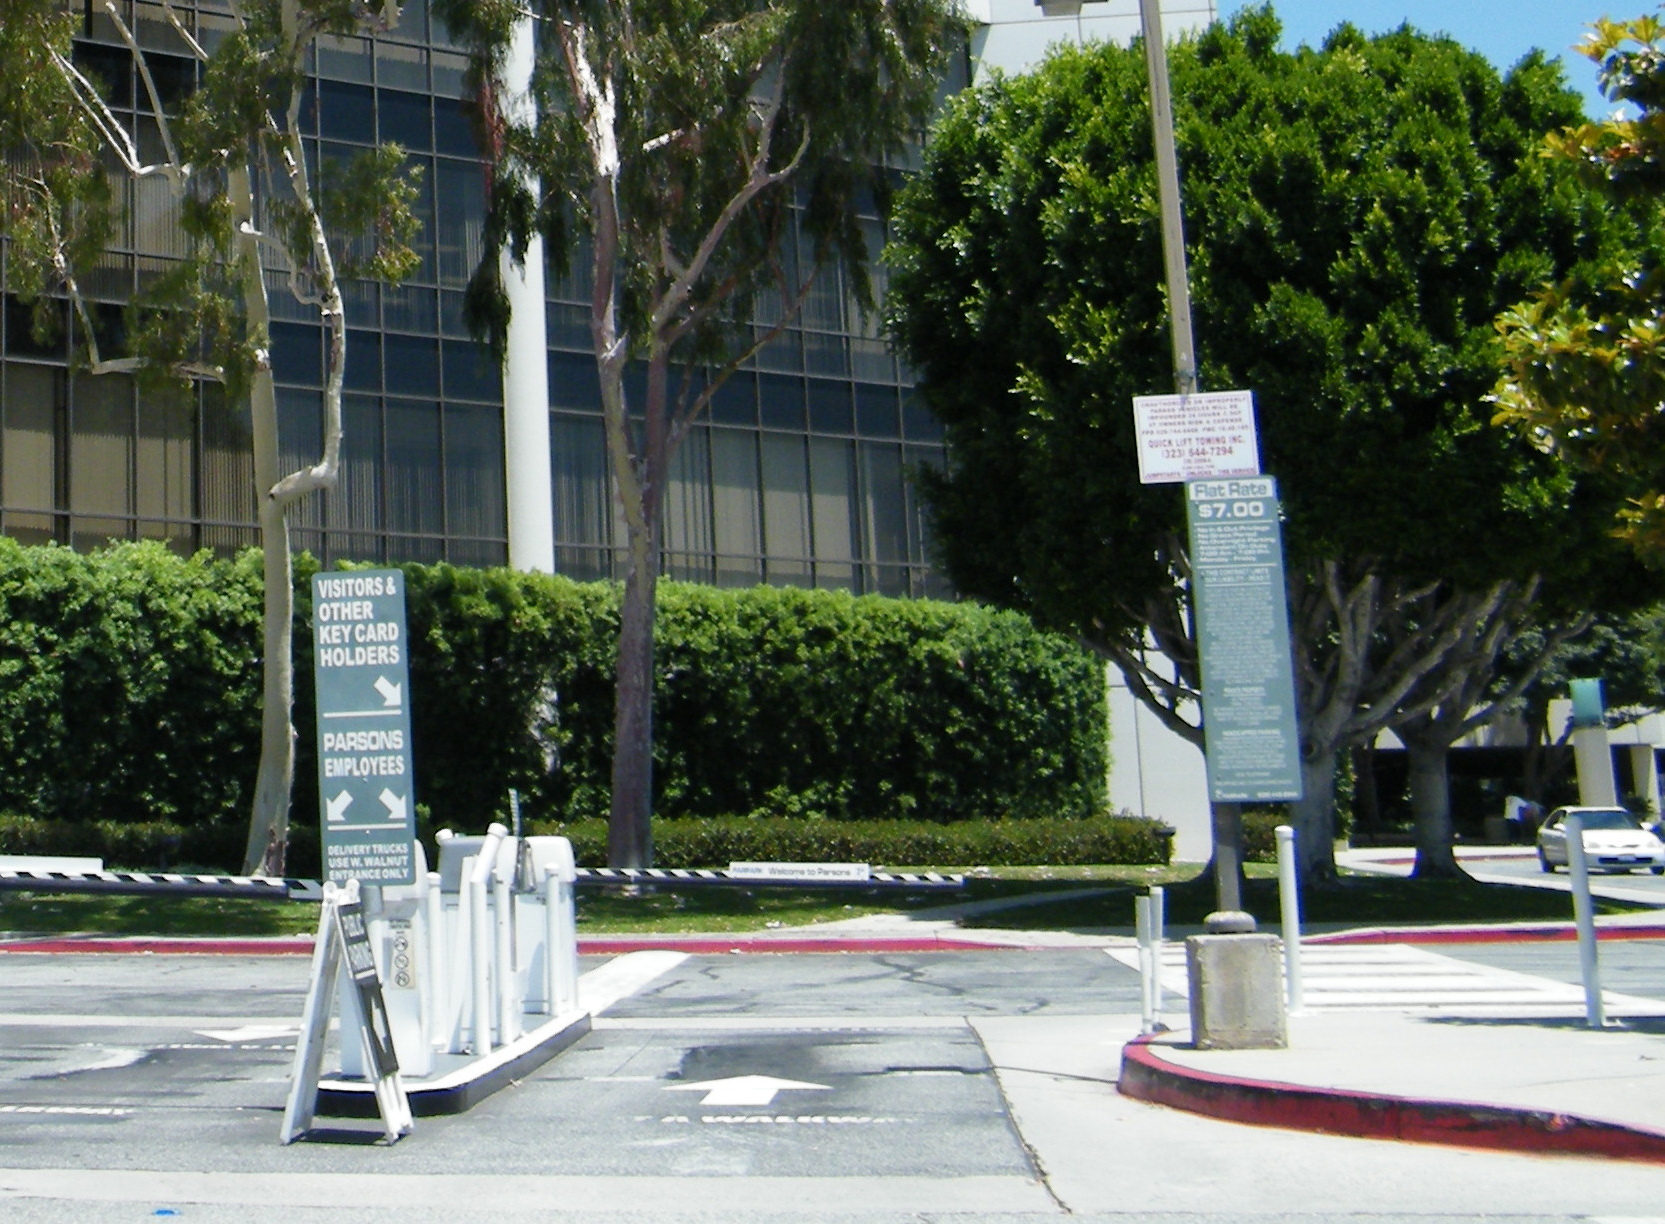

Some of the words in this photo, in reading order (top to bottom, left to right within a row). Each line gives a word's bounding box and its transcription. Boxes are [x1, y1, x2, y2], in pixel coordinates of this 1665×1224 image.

[1148, 439, 1173, 448] QUICK
[1176, 438, 1192, 447] LIFT
[1195, 436, 1226, 446] TOWING
[1162, 449, 1185, 458] (323)
[1195, 483, 1225, 497] Flat
[1229, 482, 1267, 496] Rate
[1198, 501, 1264, 518] $7.00
[318, 577, 383, 598] VISITORS
[386, 576, 396, 595] &
[319, 601, 374, 622] OTHER
[319, 624, 352, 644] KEY
[355, 622, 399, 642] CARD
[320, 645, 400, 667] HOLDERS
[323, 730, 403, 752] PARSONS
[324, 756, 405, 777] EMPLOYEES
[327, 844, 371, 856] DELIVERY
[372, 843, 408, 854] TRUCKS
[328, 857, 349, 868] USE
[350, 857, 363, 867] W.
[364, 856, 408, 867] WALNUT
[329, 868, 381, 881] ENTRANCE
[382, 868, 409, 879] ONLY
